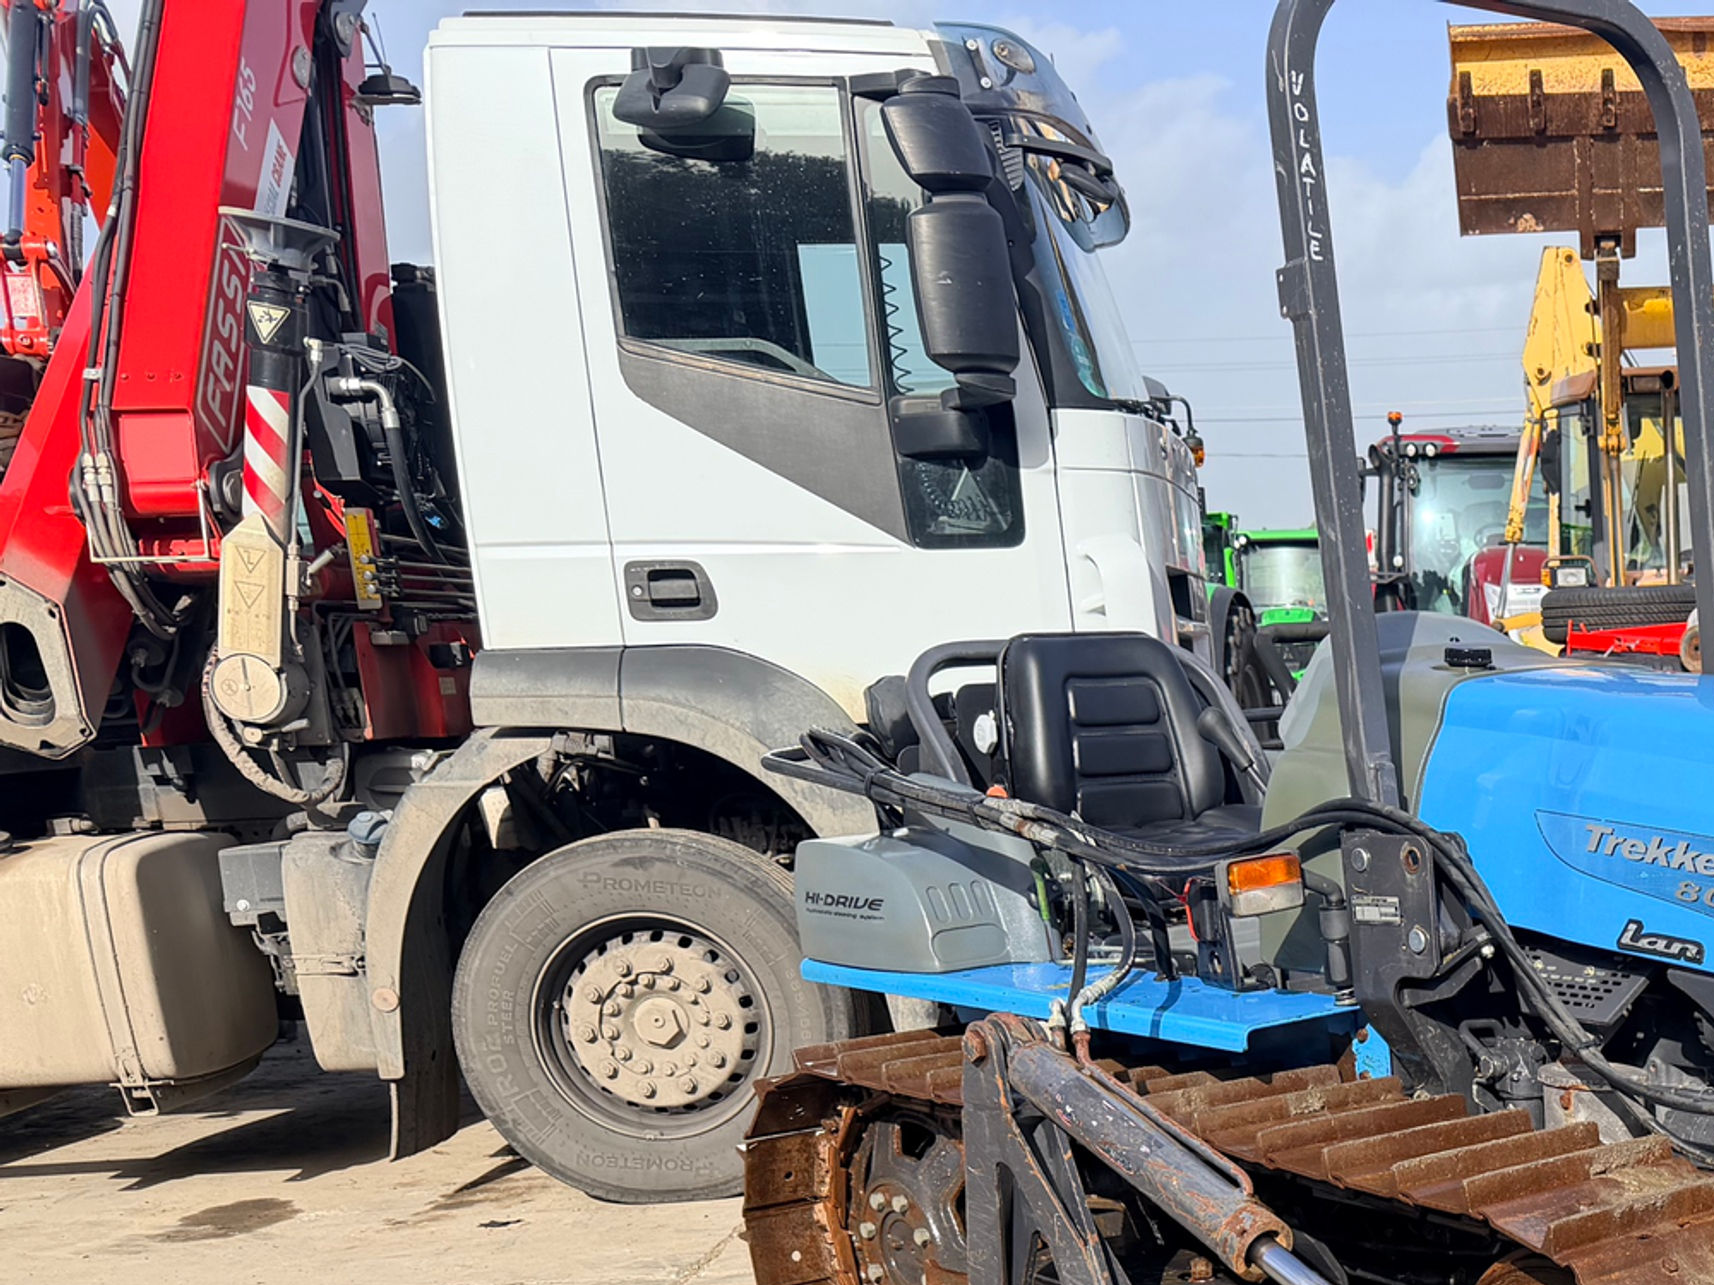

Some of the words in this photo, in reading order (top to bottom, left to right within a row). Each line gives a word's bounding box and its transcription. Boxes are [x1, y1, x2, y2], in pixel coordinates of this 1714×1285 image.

[1290, 69, 1324, 261] VOLATILE
[206, 248, 247, 428] FASSI
[576, 871, 722, 899] PROMETEON
[804, 890, 885, 911] HI-DRIVE
[502, 989, 516, 1045] STEER
